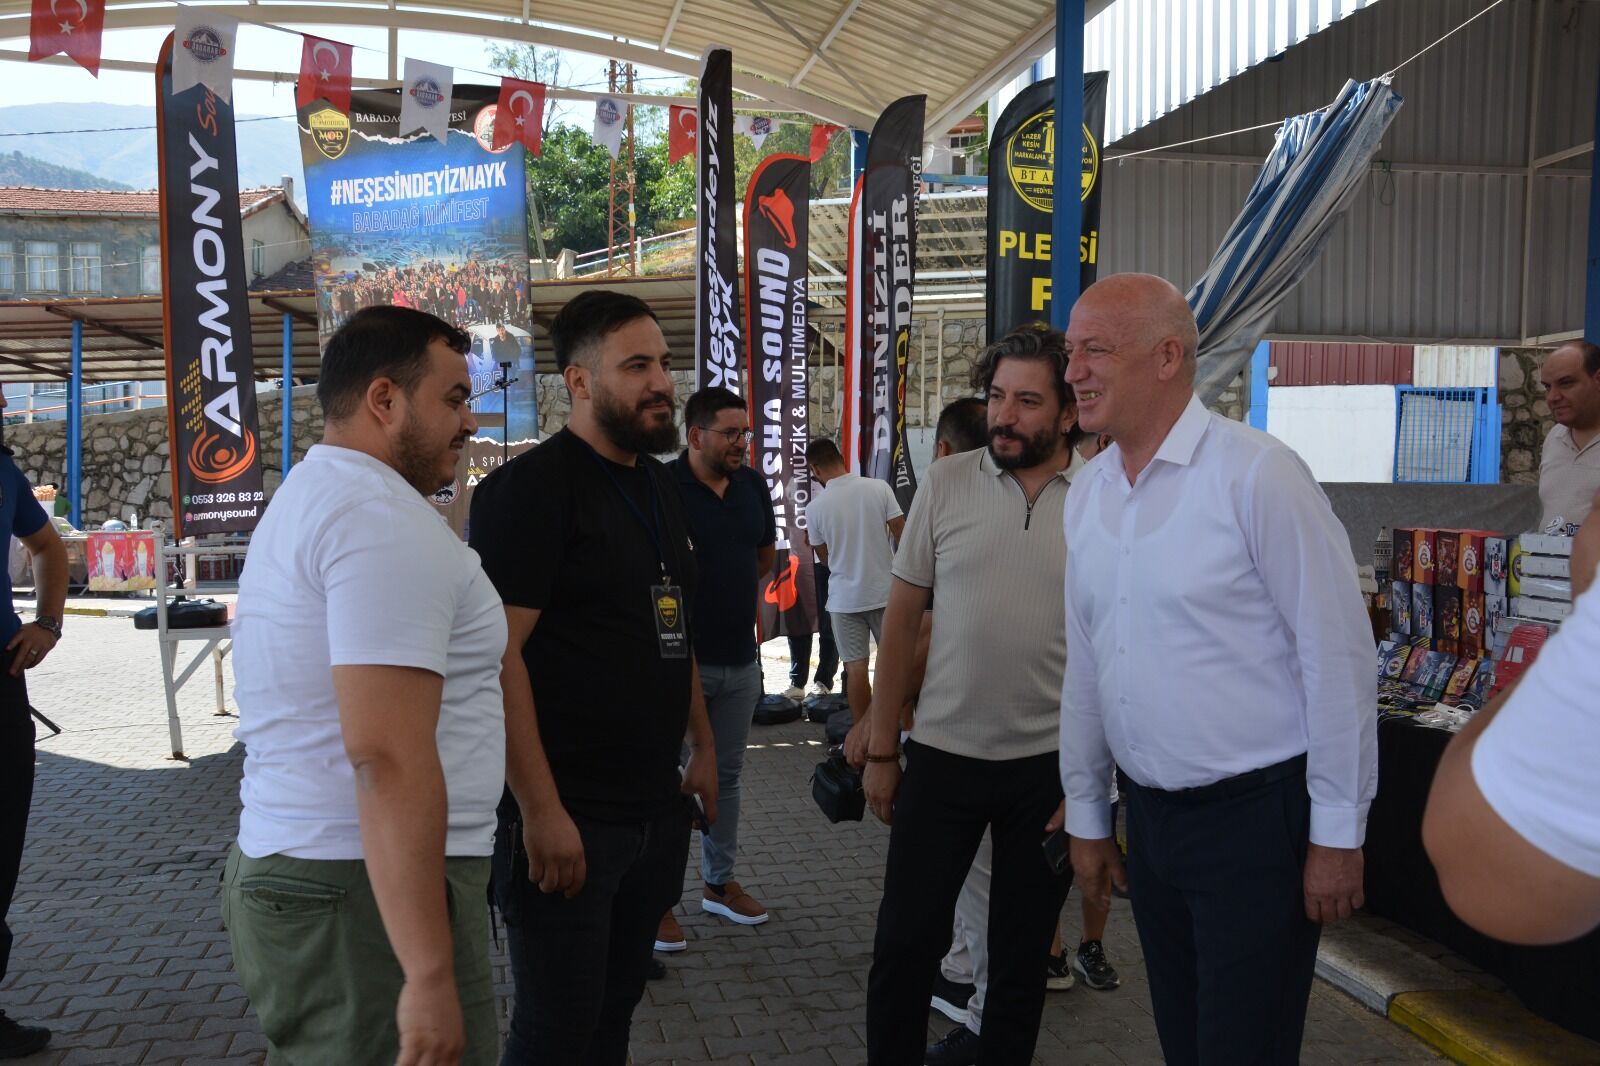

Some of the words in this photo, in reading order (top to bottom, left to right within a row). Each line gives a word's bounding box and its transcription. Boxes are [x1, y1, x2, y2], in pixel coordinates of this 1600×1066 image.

[330, 161, 507, 208] #NEŞESİNDEYİZMAYK
[352, 201, 420, 233] BABADAĞ
[189, 131, 242, 438] ARMONY
[756, 248, 790, 384] SOUND
[789, 277, 806, 399] MULTİMEDYA
[867, 208, 891, 456] DENİZLİ
[791, 405, 806, 419] &
[789, 425, 808, 483] MÜZİK
[192, 494, 214, 505] 0553
[216, 493, 236, 503] 326
[238, 492, 251, 501] 83
[253, 491, 264, 501] 22
[794, 489, 808, 530] OTO
